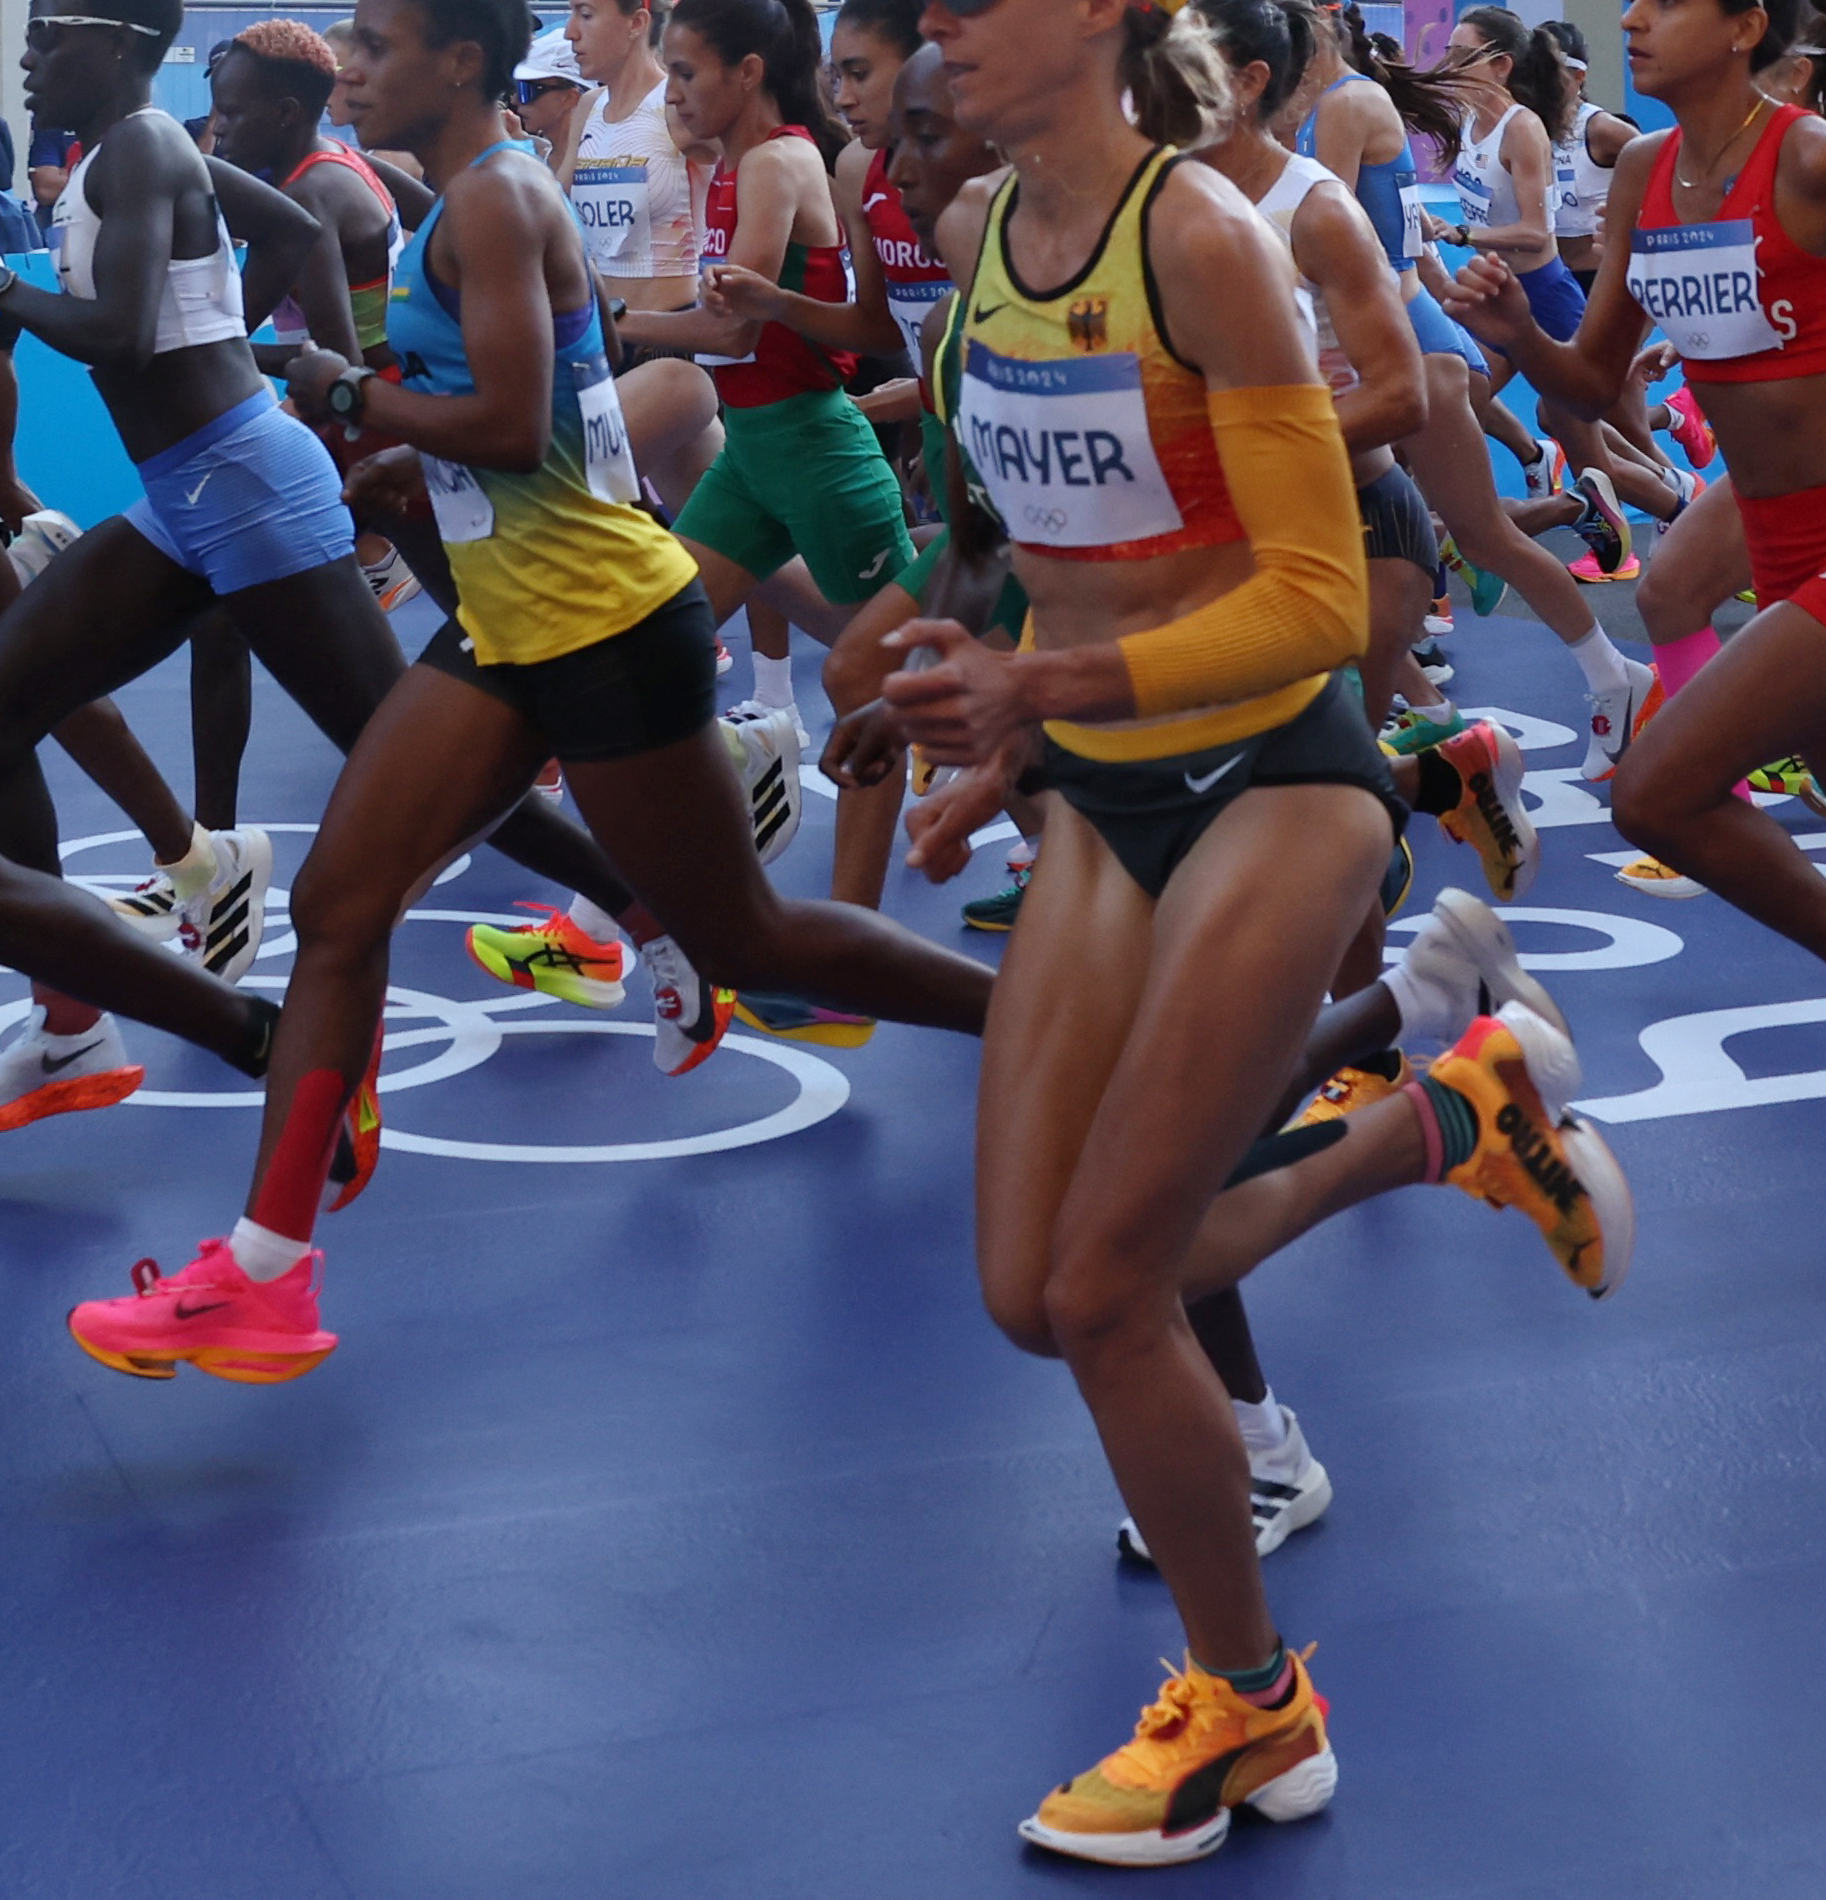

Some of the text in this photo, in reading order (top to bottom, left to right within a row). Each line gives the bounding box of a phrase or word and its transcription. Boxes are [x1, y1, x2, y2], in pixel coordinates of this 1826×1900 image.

[1630, 271, 1757, 319] PERRIER
[1016, 368, 1067, 388] 2024
[971, 411, 1136, 486] MAYER
